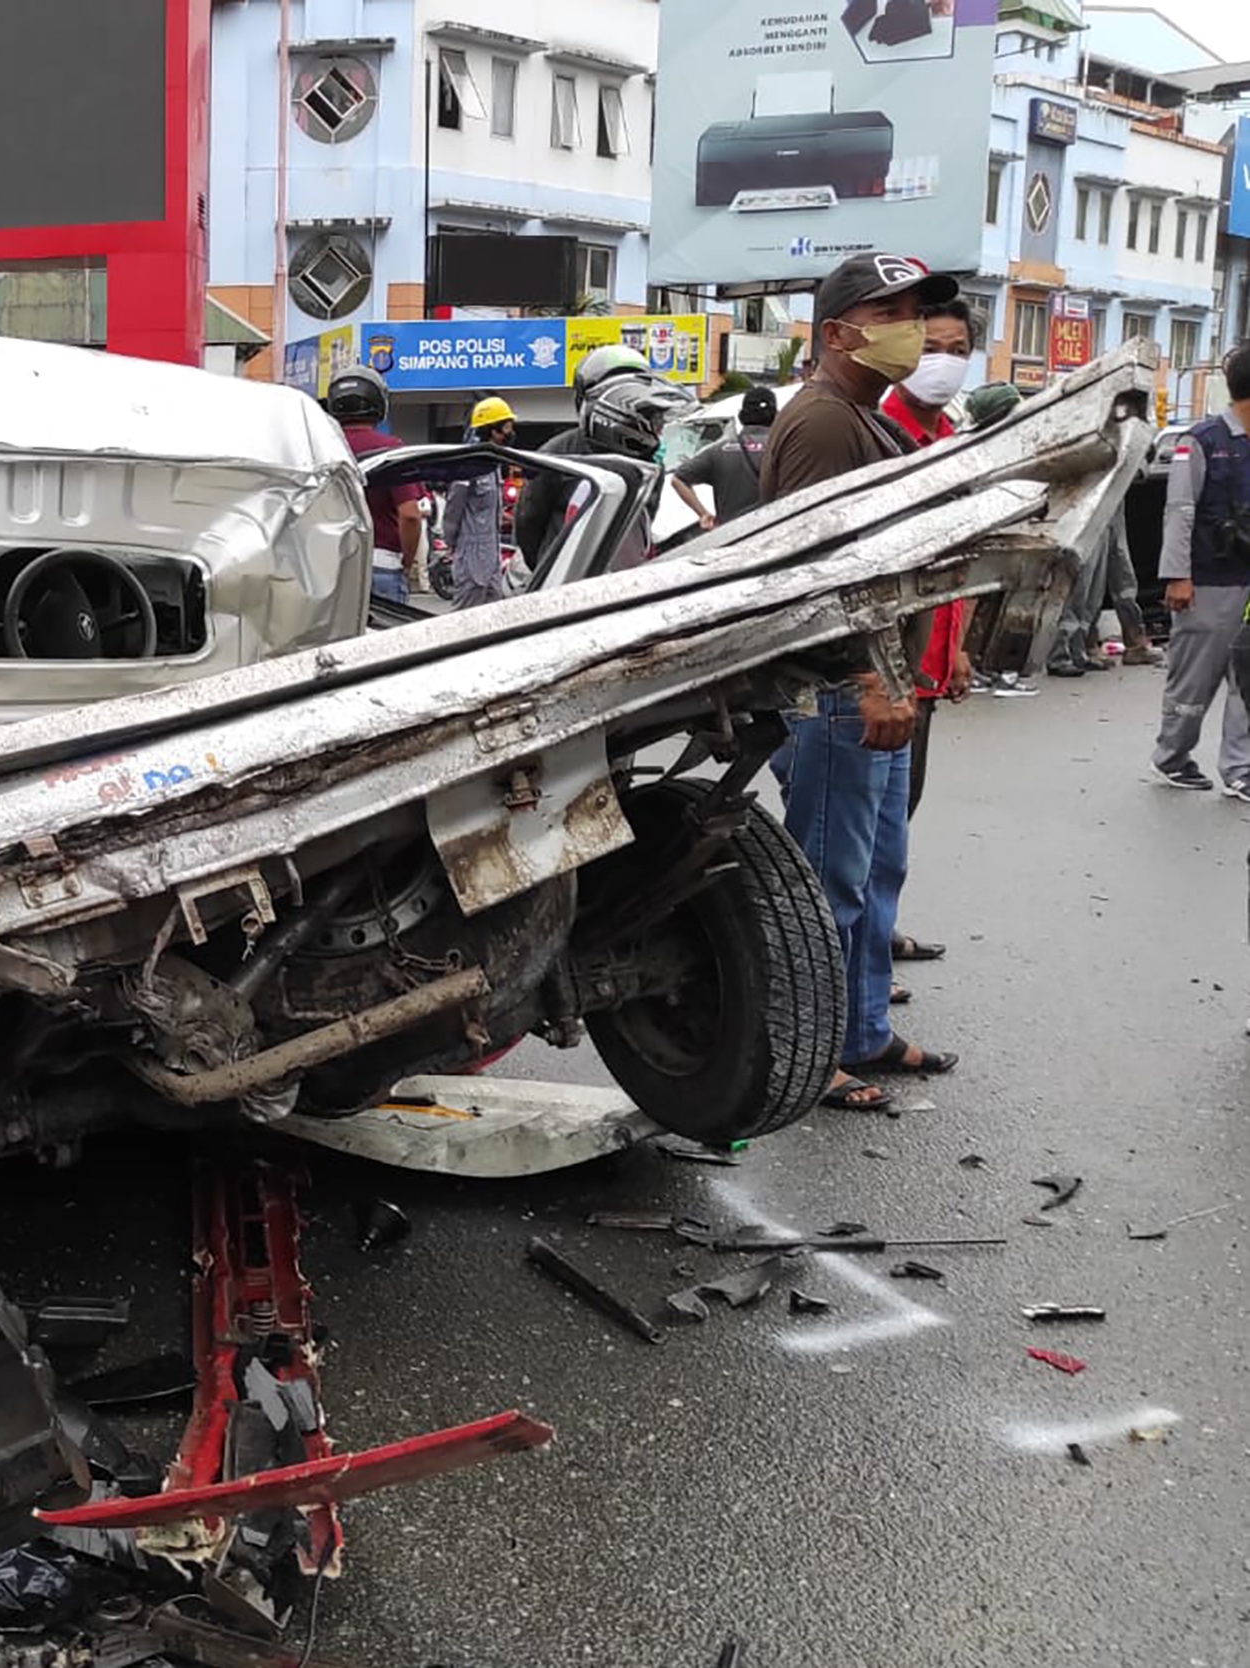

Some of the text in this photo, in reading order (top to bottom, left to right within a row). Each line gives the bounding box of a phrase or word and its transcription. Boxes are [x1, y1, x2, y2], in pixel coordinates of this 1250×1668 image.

[761, 14, 828, 26] KEMUDAHAN
[765, 27, 827, 39] MENGGANTI
[419, 338, 505, 354] POS POLISI
[398, 353, 525, 371] SIMPANG RAPAK
